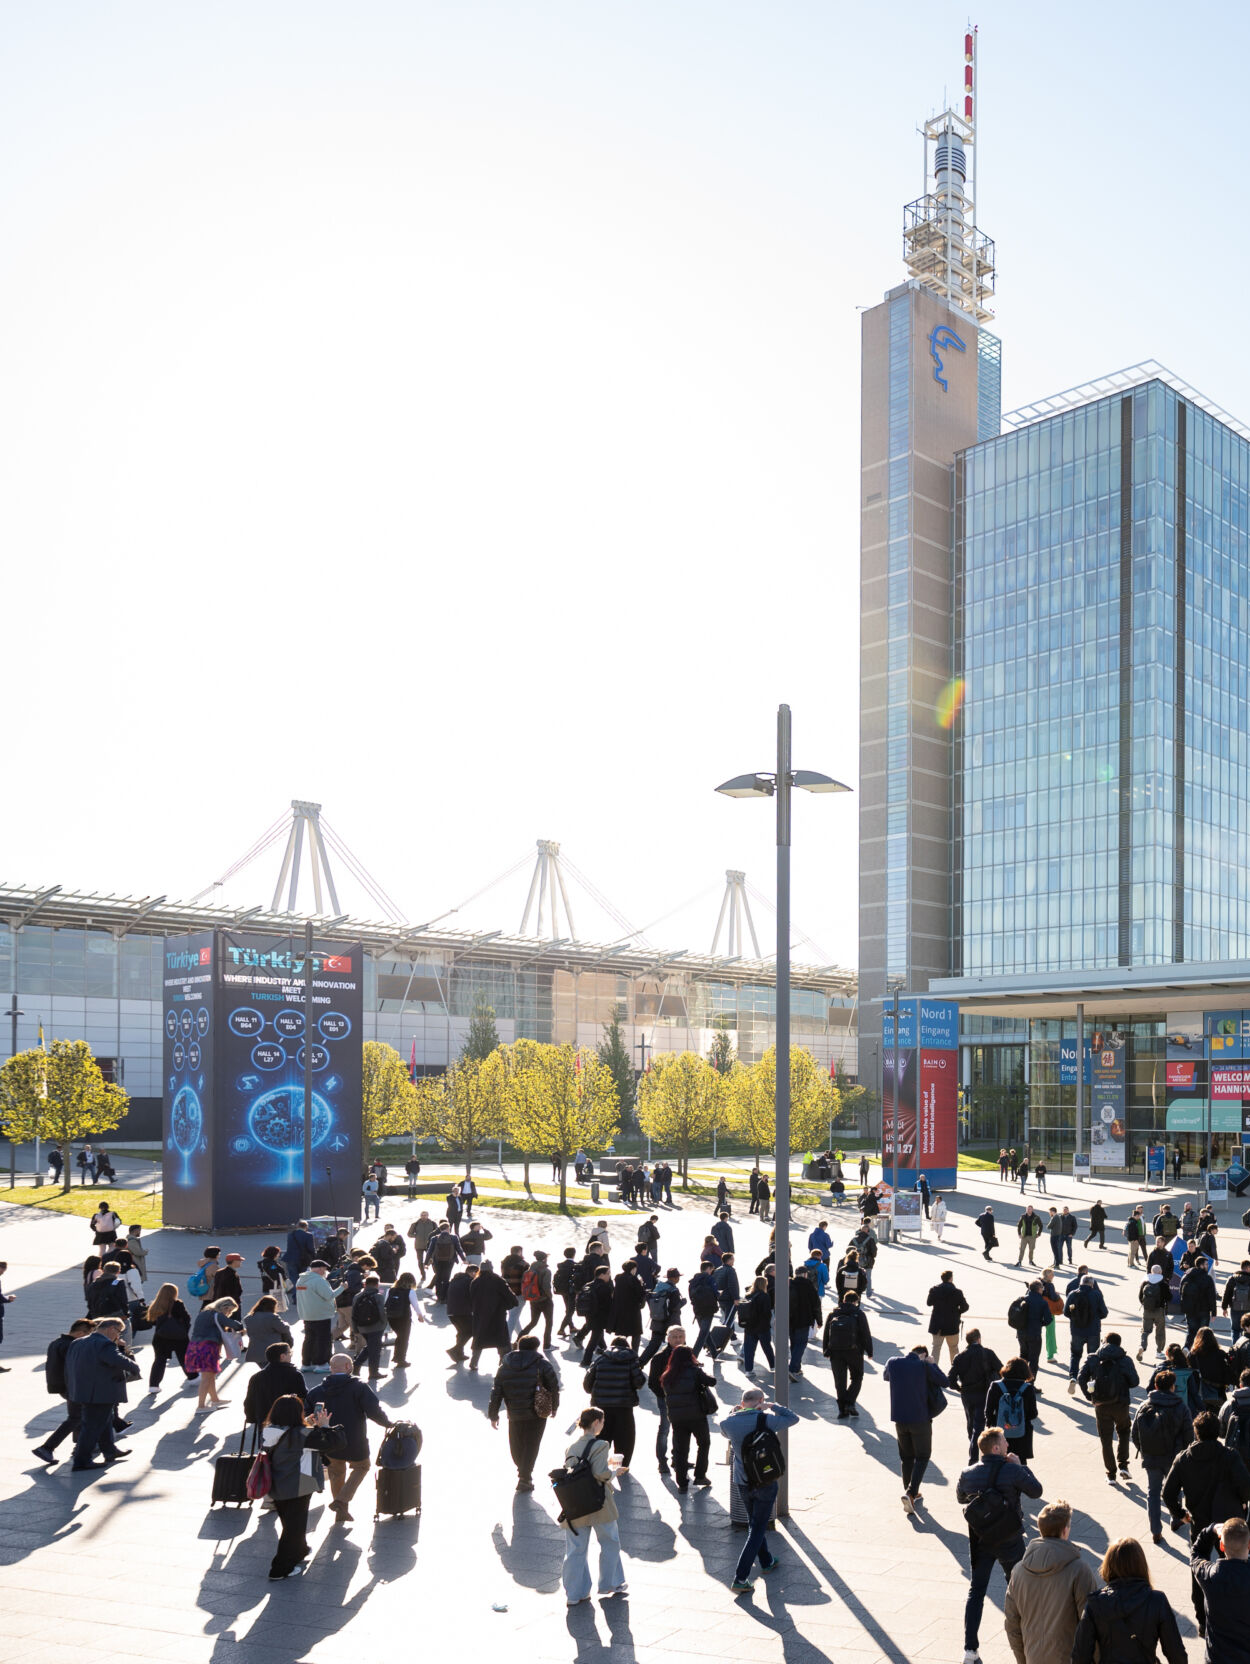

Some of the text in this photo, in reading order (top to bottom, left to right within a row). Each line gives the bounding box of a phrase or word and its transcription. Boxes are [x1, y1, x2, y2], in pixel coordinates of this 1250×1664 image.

[166, 950, 198, 971] Türkiye
[224, 974, 252, 984] WHERE
[254, 976, 291, 986] INDUSTRY
[282, 986, 302, 994] MEET
[252, 992, 331, 1004] TURKISH WELCMING
[922, 1008, 952, 1020] Nord 1
[884, 1027, 909, 1036] Einang
[922, 1026, 950, 1037] Eingang
[922, 1037, 952, 1045] Entrance
[903, 1144, 913, 1153] 27
